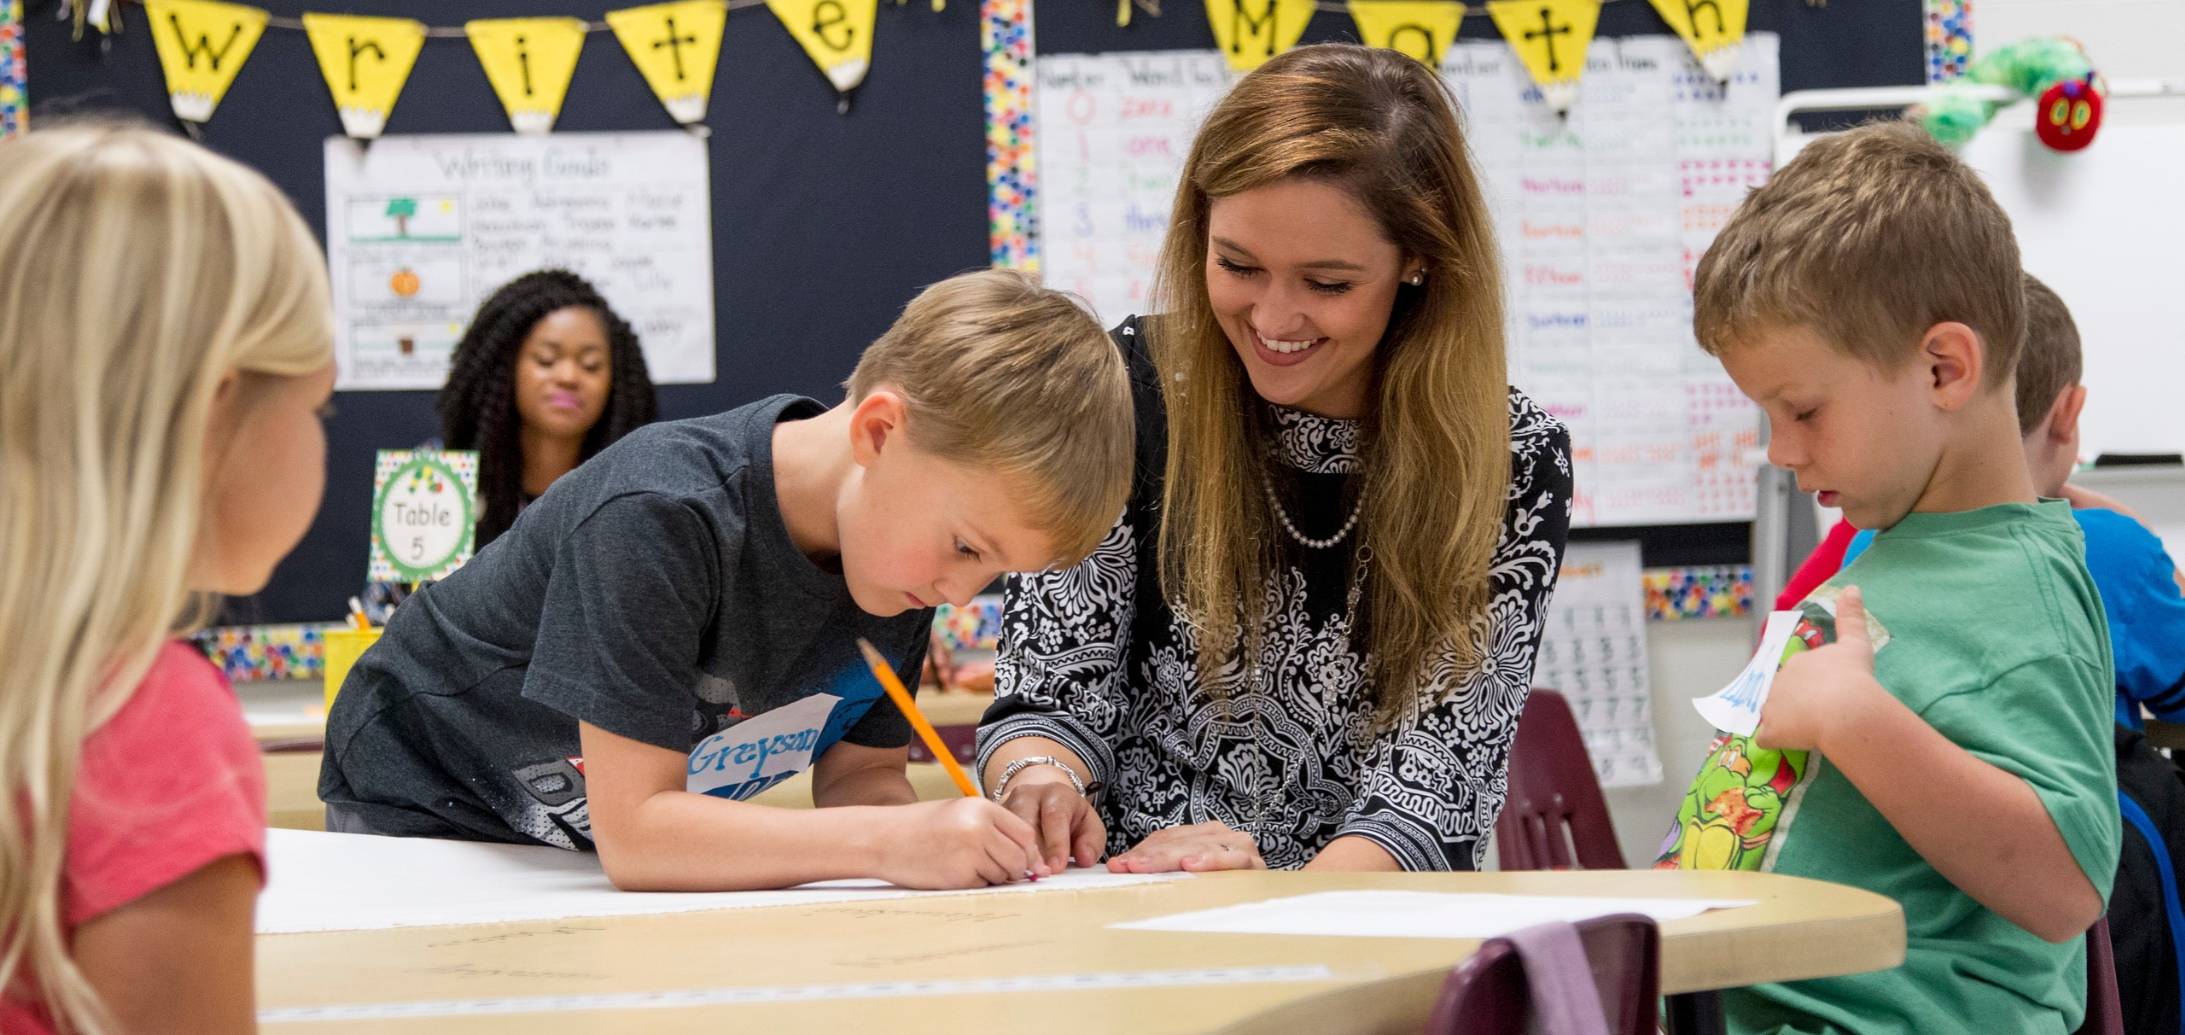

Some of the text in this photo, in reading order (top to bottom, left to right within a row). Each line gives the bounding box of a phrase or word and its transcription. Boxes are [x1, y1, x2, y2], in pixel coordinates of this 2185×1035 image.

[394, 501, 451, 527] Table
[410, 535, 424, 560] 5
[688, 728, 819, 779] Greyson
